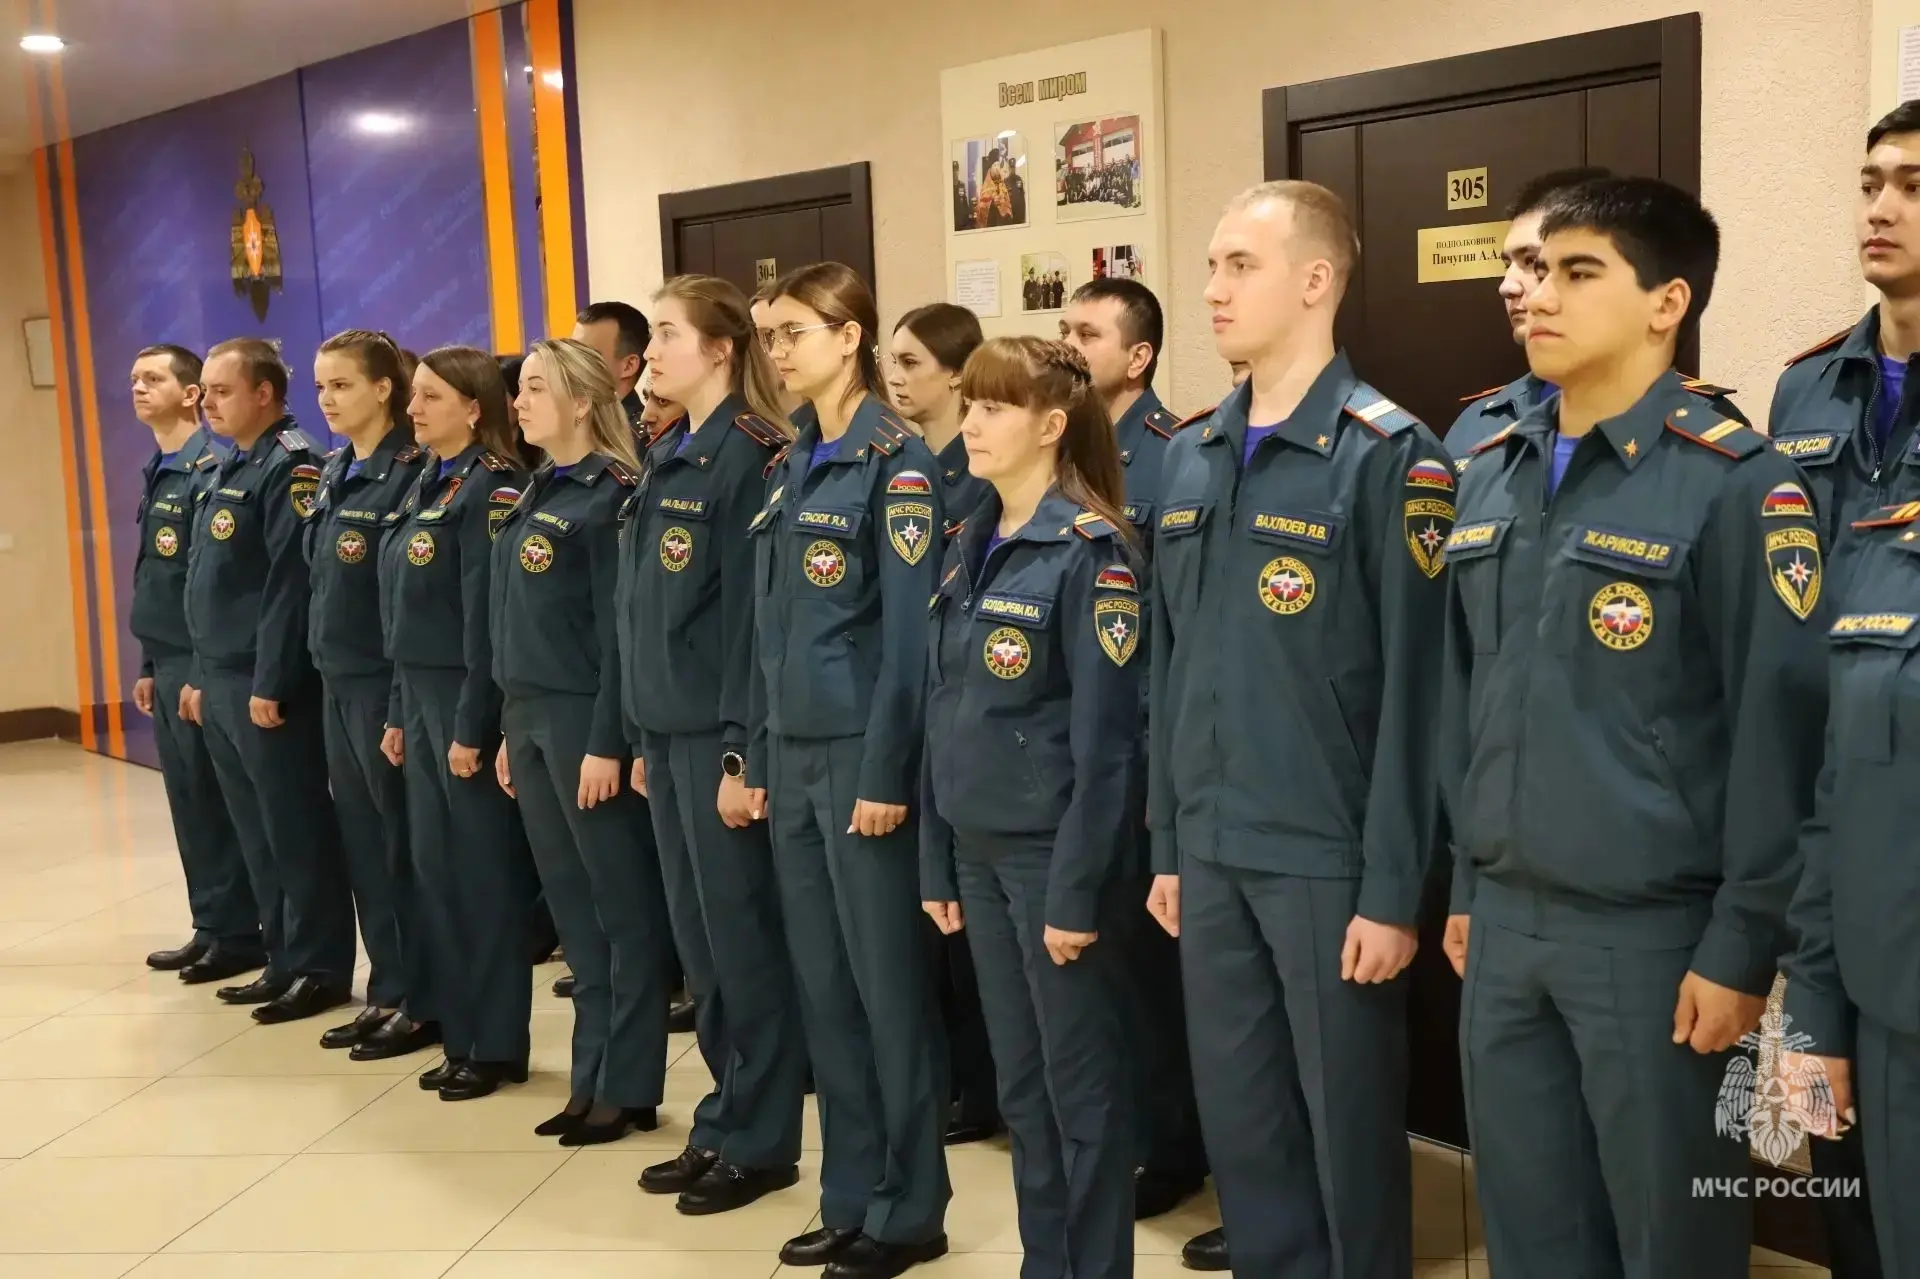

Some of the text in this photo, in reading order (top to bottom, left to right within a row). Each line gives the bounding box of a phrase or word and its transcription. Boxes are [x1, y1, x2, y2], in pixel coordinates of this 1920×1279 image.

[999, 72, 1087, 108] Всем миром
[1450, 176, 1485, 202] 305
[1432, 252, 1476, 266] Пичугин
[758, 264, 775, 282] 304
[1775, 436, 1833, 456] МЧС РОССИИ
[889, 505, 930, 516] МЧС РОССИИ
[1407, 502, 1426, 513] МЧС
[799, 511, 831, 524] СТАСЮК
[1769, 532, 1788, 547] МЧС
[1263, 559, 1313, 585] МЧС РОССИИ
[1097, 600, 1114, 611] МЧС
[1261, 587, 1312, 612] EMERCOM
[1615, 584, 1650, 618] РОССИИ
